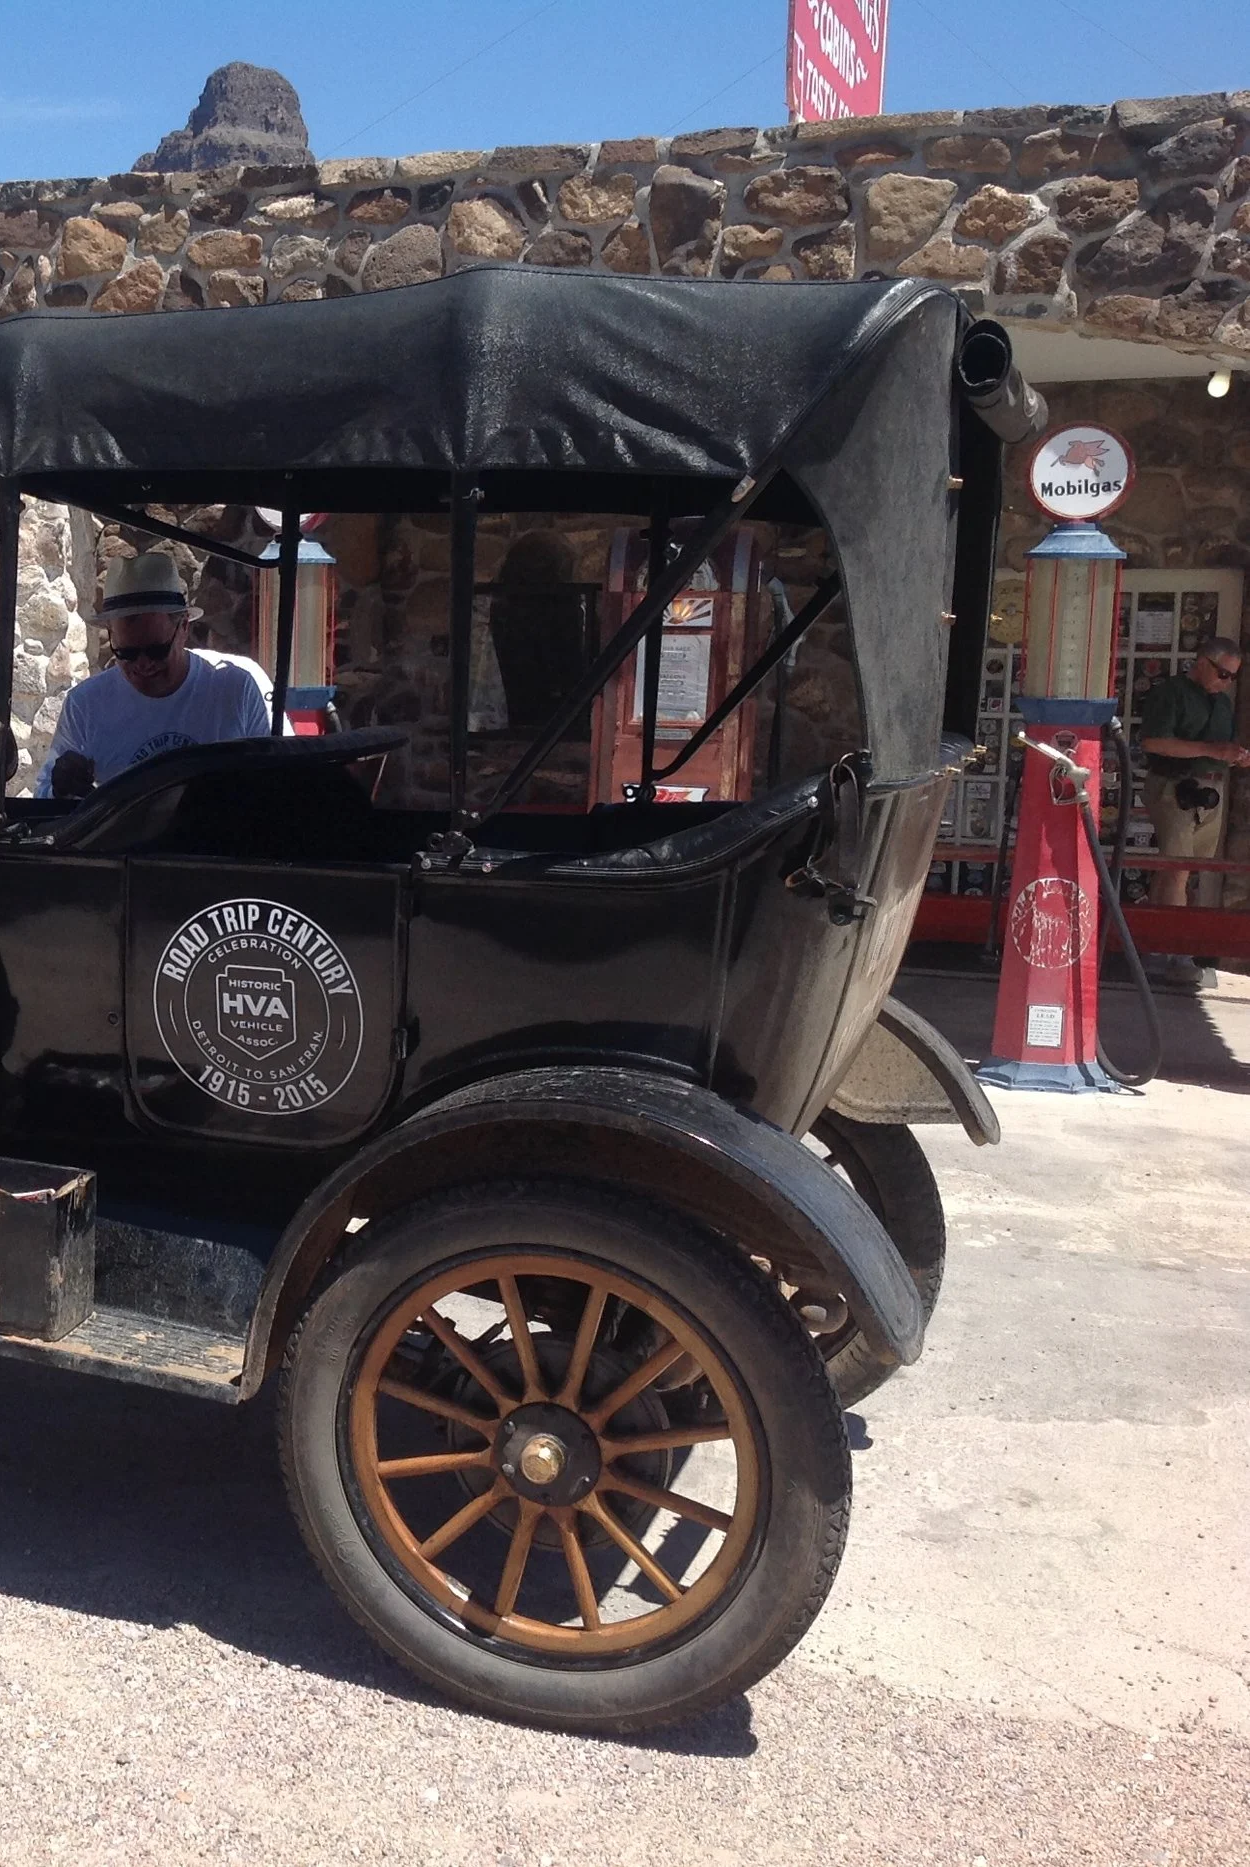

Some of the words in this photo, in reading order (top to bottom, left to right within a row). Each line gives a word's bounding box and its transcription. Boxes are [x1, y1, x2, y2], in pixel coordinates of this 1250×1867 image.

[820, 0, 856, 89] CABINS
[806, 59, 837, 120] TASTY
[1040, 478, 1122, 498] Mobilgas
[161, 922, 210, 983] ROAD
[207, 904, 260, 936] TRIP
[267, 907, 354, 996] CENTURY
[207, 938, 303, 970] CELEBRATION
[228, 978, 282, 991] HISTORIC
[222, 992, 290, 1019] HVA
[230, 1019, 284, 1032] VEHICLE
[237, 1033, 279, 1047] ASSOC.
[192, 1020, 239, 1072] DETROIT
[245, 1068, 263, 1080] TO
[269, 1064, 297, 1081] SAN
[299, 1030, 324, 1067] FRAN.
[198, 1064, 250, 1106] 1915
[273, 1073, 329, 1110] 2015
